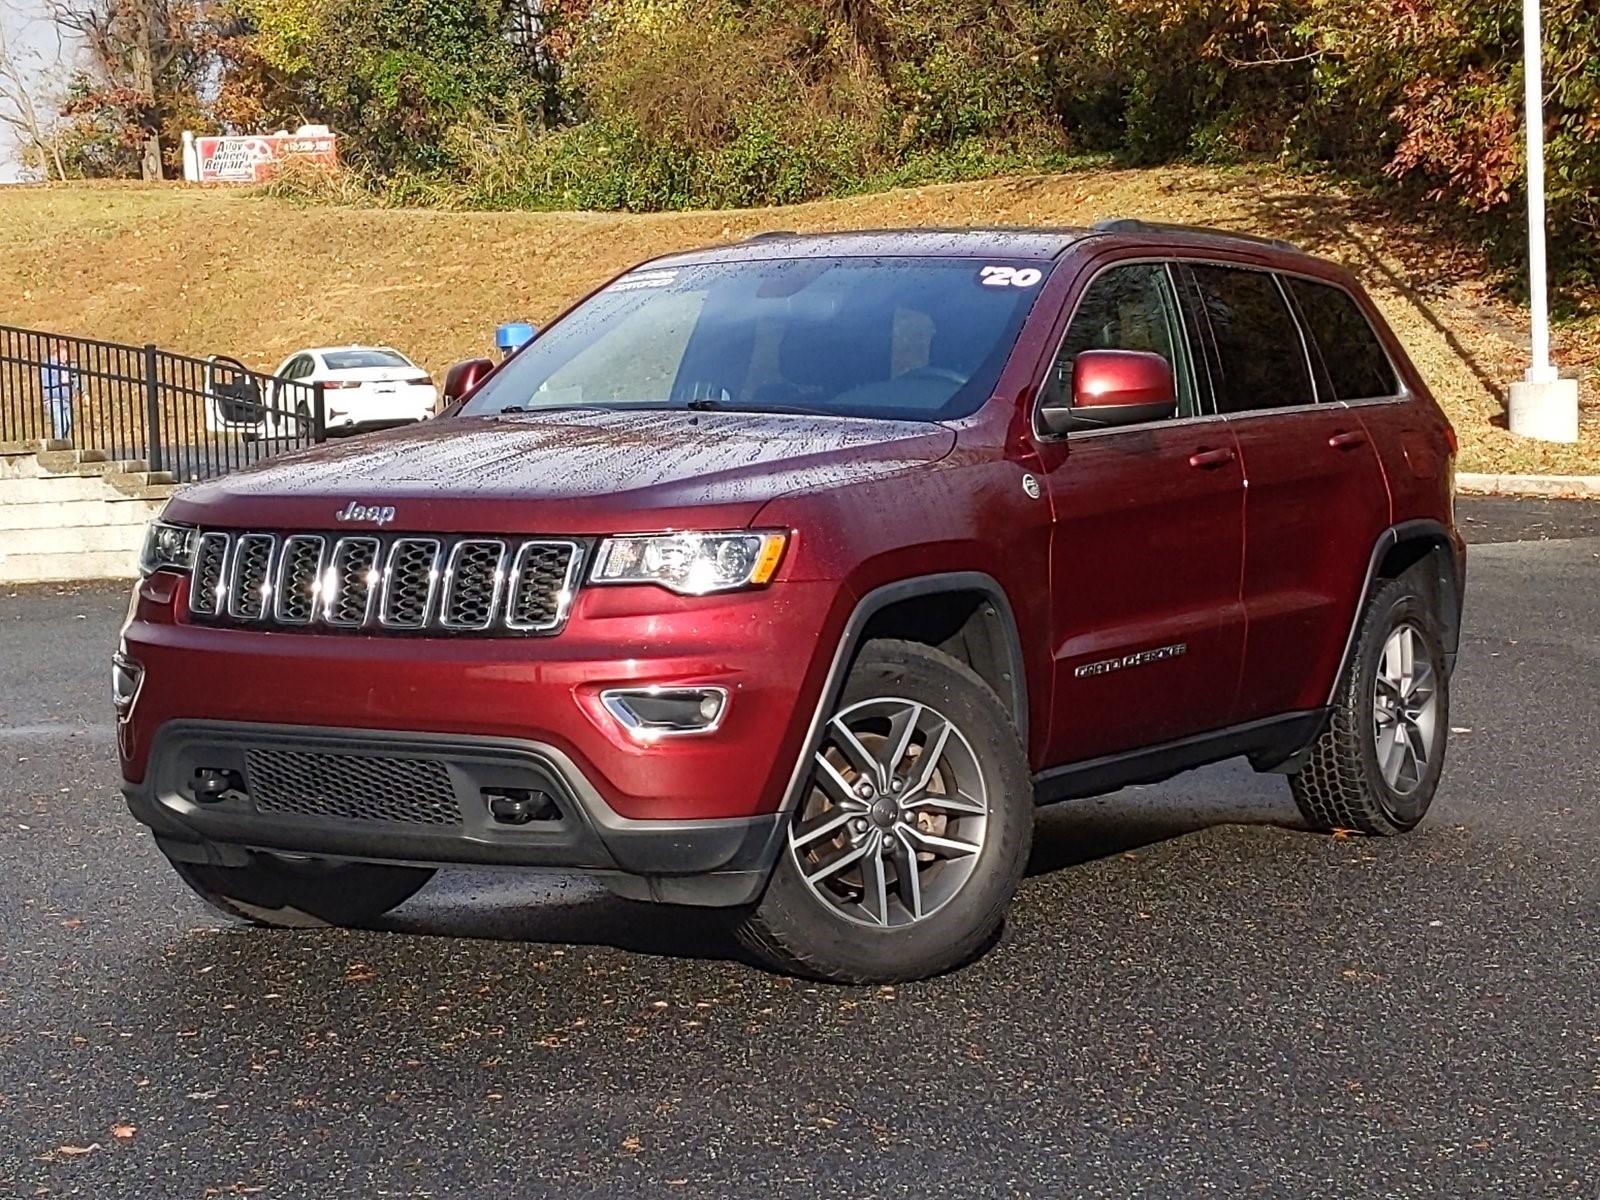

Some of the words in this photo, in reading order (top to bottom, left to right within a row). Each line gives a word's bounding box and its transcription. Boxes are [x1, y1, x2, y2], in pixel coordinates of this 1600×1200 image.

[217, 141, 243, 152] Alloy
[205, 159, 244, 173] Repair
[335, 501, 395, 526] Jeep
